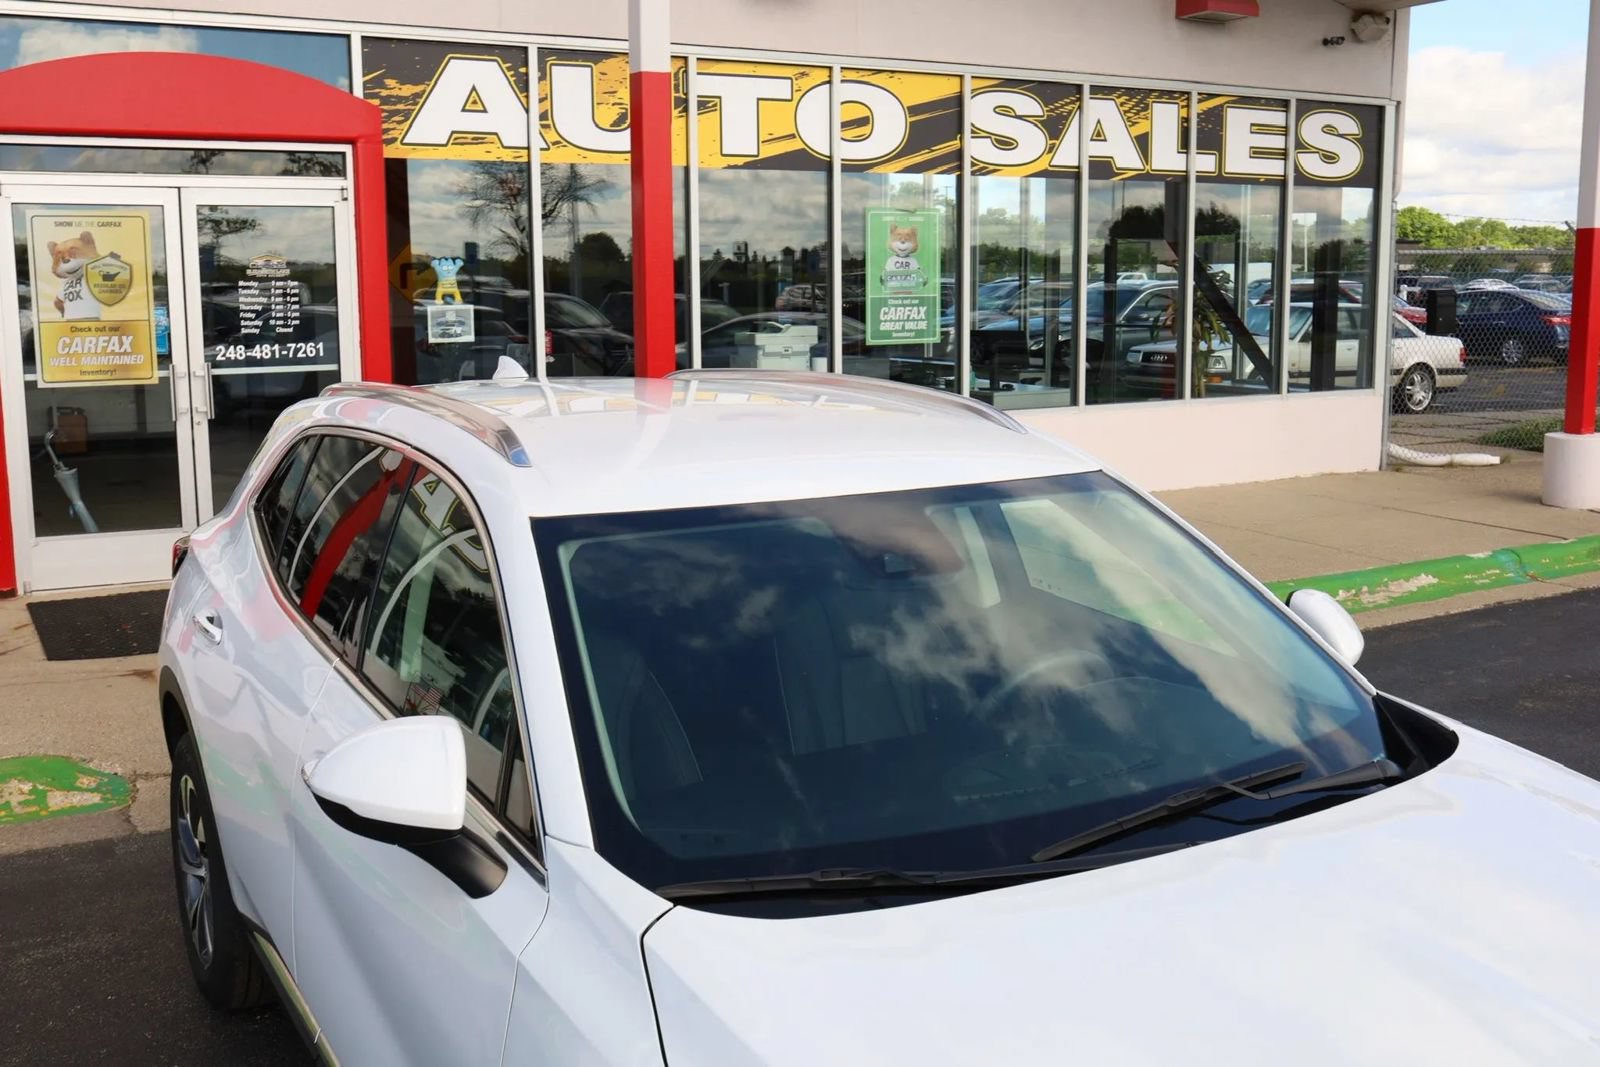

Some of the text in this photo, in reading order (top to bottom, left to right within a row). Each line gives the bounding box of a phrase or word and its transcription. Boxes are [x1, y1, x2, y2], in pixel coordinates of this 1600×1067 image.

[399, 54, 1363, 181] AUTO SALES
[894, 261, 911, 269] CAR
[880, 306, 927, 321] CARFAX
[880, 321, 928, 331] GREAT VALUE
[57, 335, 134, 354] CARFAX
[215, 342, 324, 361] 248-481-7261
[50, 355, 144, 366] WELL MAINTAINED
